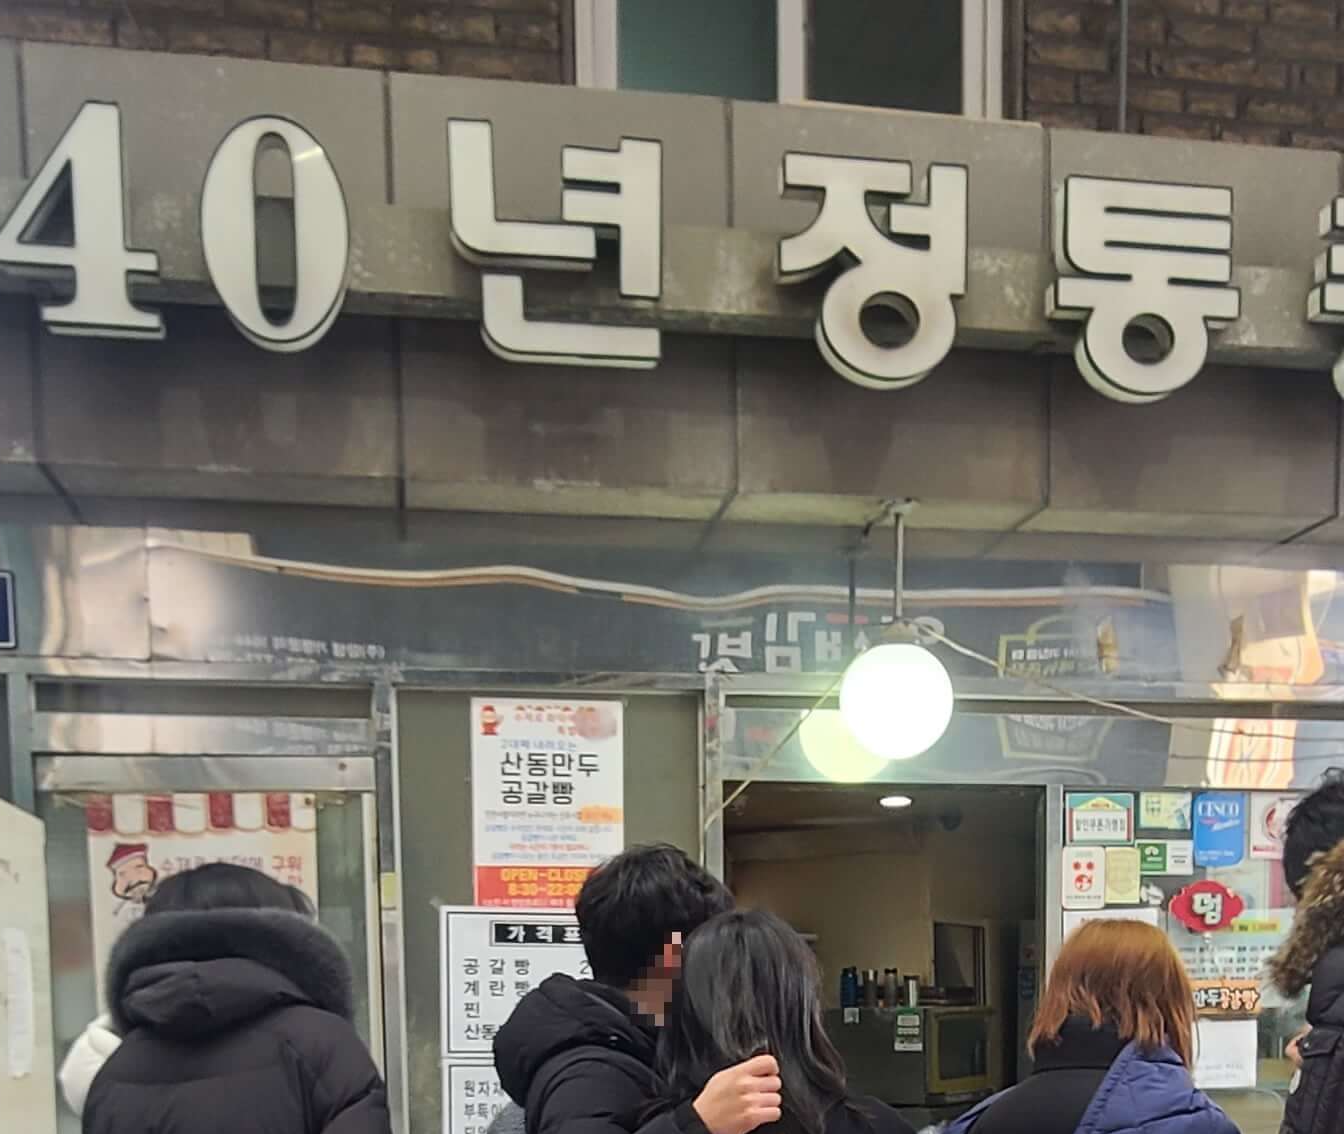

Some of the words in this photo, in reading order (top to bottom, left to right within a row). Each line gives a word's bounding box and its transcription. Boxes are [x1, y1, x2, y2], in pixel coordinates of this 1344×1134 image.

[500, 751, 600, 778] 산동만두
[500, 780, 575, 806] 공갈빵
[462, 958, 530, 976] 공갈빵
[463, 980, 530, 998] 계란빵
[464, 1023, 498, 1041] 산동
